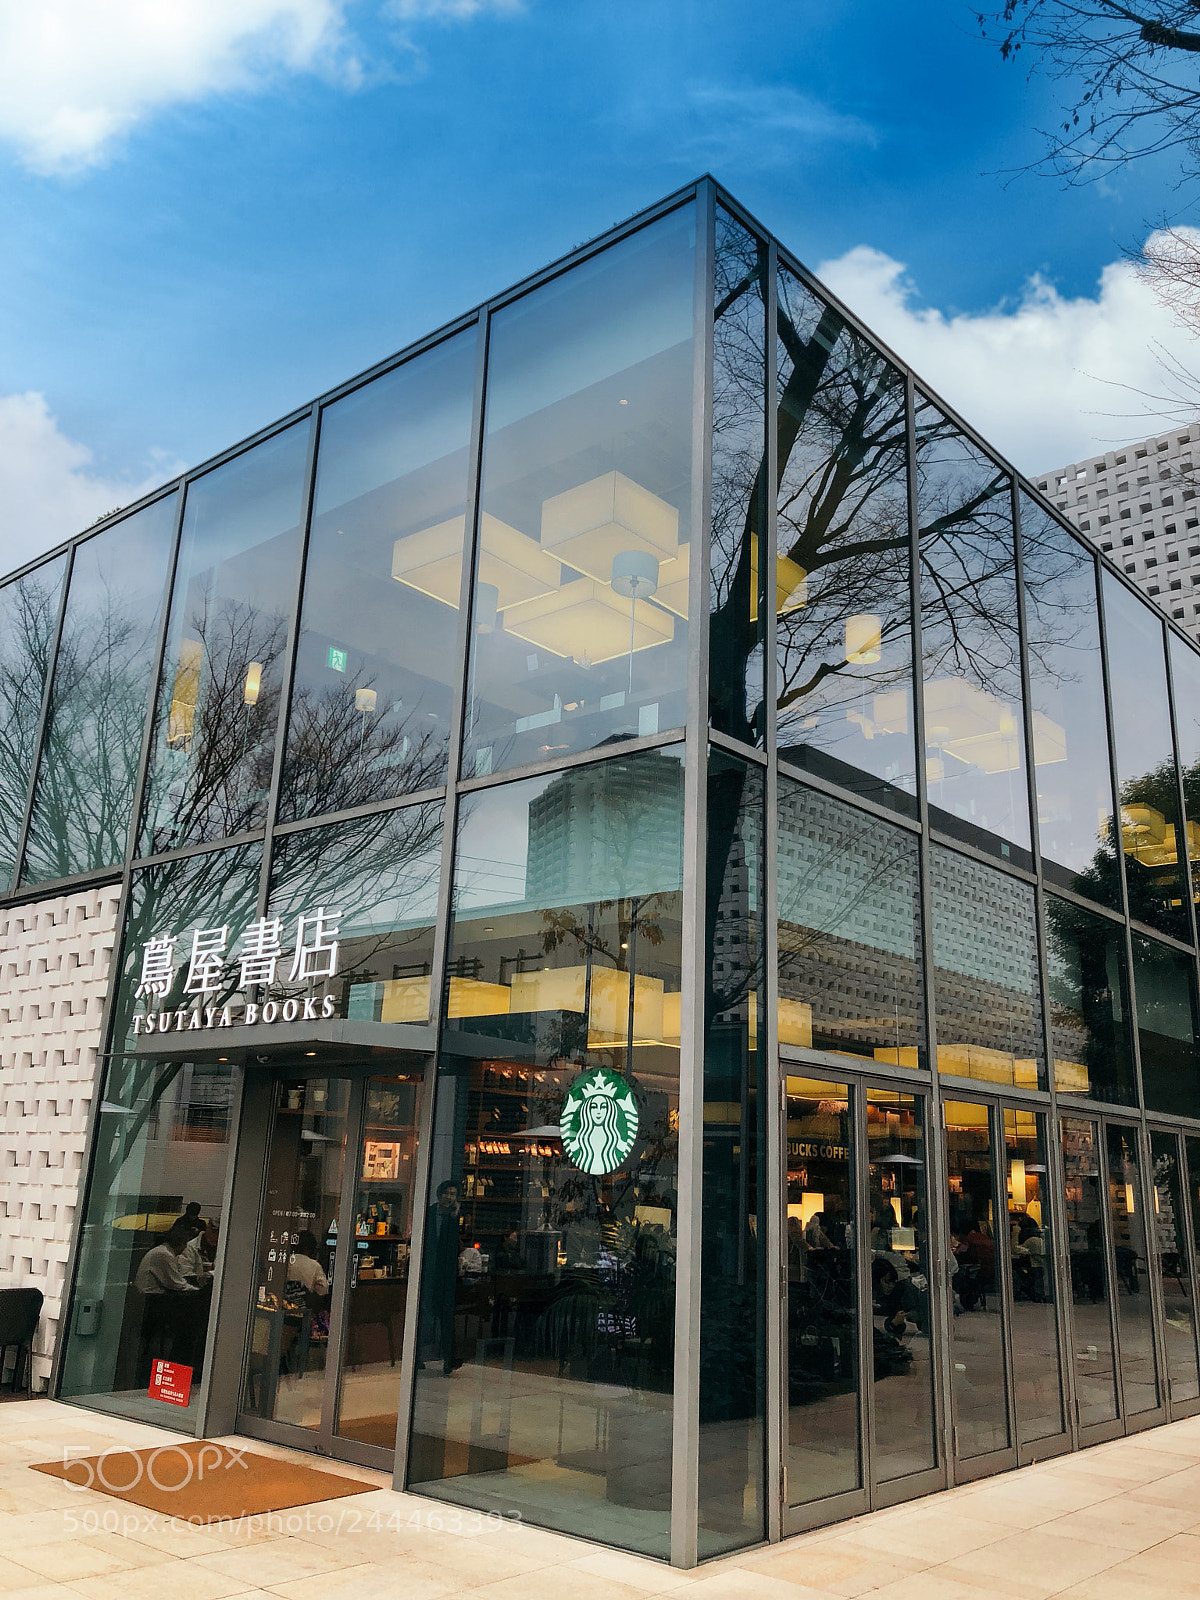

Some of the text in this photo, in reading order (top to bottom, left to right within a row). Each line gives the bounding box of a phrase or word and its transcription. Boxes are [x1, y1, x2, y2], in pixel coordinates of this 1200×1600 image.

[134, 906, 345, 999] 蔦屋書店
[132, 994, 336, 1034] TSUTAYA BOOKS
